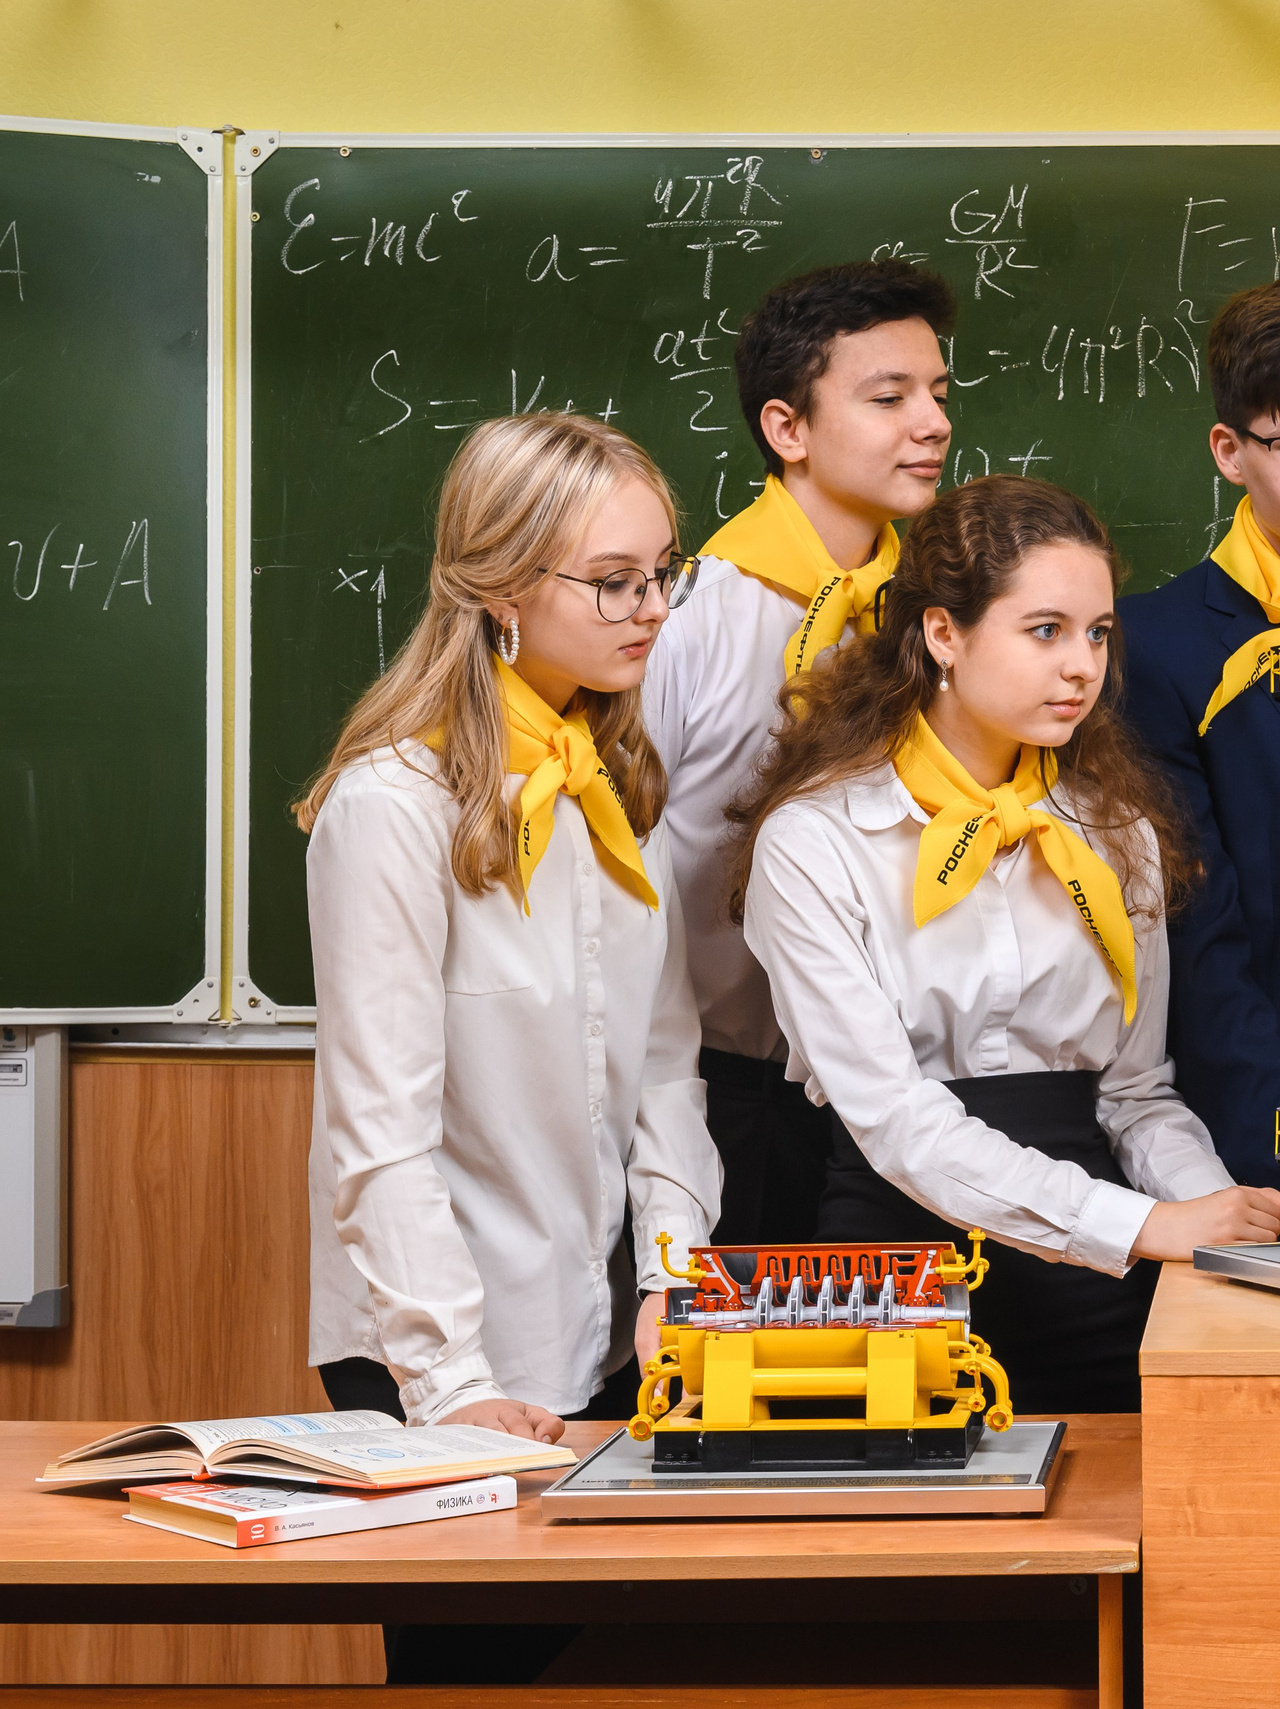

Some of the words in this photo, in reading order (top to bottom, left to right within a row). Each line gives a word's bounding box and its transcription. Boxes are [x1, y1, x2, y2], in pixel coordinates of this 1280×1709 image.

[690, 390, 729, 432] 2
[436, 1495, 473, 1509] ФИЗИКА
[251, 1522, 265, 1540] 10
[288, 1521, 315, 1529] Касьянов
